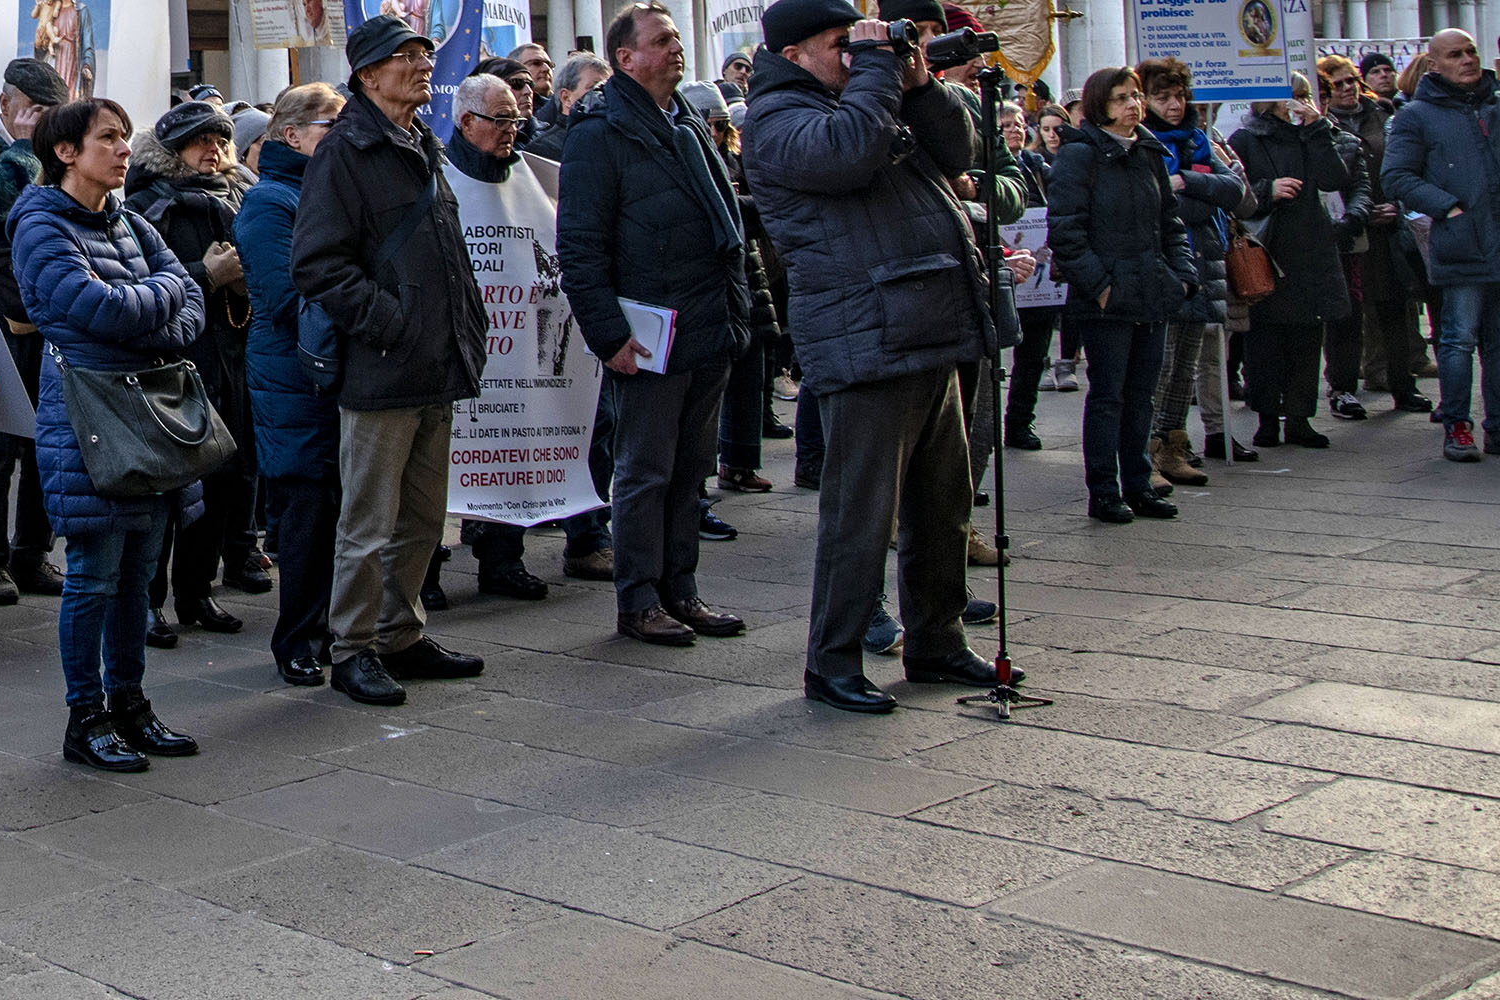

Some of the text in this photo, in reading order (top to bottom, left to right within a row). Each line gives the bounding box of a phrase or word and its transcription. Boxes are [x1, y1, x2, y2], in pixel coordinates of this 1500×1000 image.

[484, 2, 526, 30] MARIANO
[712, 5, 765, 34] MOVIMENTO
[1141, 8, 1194, 20] proibisce:
[1157, 32, 1199, 40] MANIPOLARE
[1290, 54, 1307, 62] mai
[1193, 69, 1234, 78] preghiera
[1202, 77, 1252, 87] sconfiggere
[464, 226, 535, 239] ABORTISTI
[473, 260, 504, 272] DALI
[478, 285, 523, 304] RTO
[488, 311, 526, 329] AVE
[487, 336, 513, 355] TO
[479, 404, 519, 413] BRUCIATE
[470, 429, 477, 438] LI
[479, 428, 499, 438] DATE
[501, 428, 510, 437] IN
[512, 428, 535, 437] PASTO
[536, 427, 542, 437] AI
[543, 427, 554, 436] TOPI
[555, 427, 560, 436] DI
[561, 426, 580, 436] FOGNA
[451, 446, 579, 465] CORDATEVI CHE SONO
[460, 469, 566, 487] CREATURE DI DIO!
[466, 502, 503, 511] Movimento
[522, 500, 539, 509] Cristo
[539, 501, 547, 509] per
[548, 499, 553, 507] la
